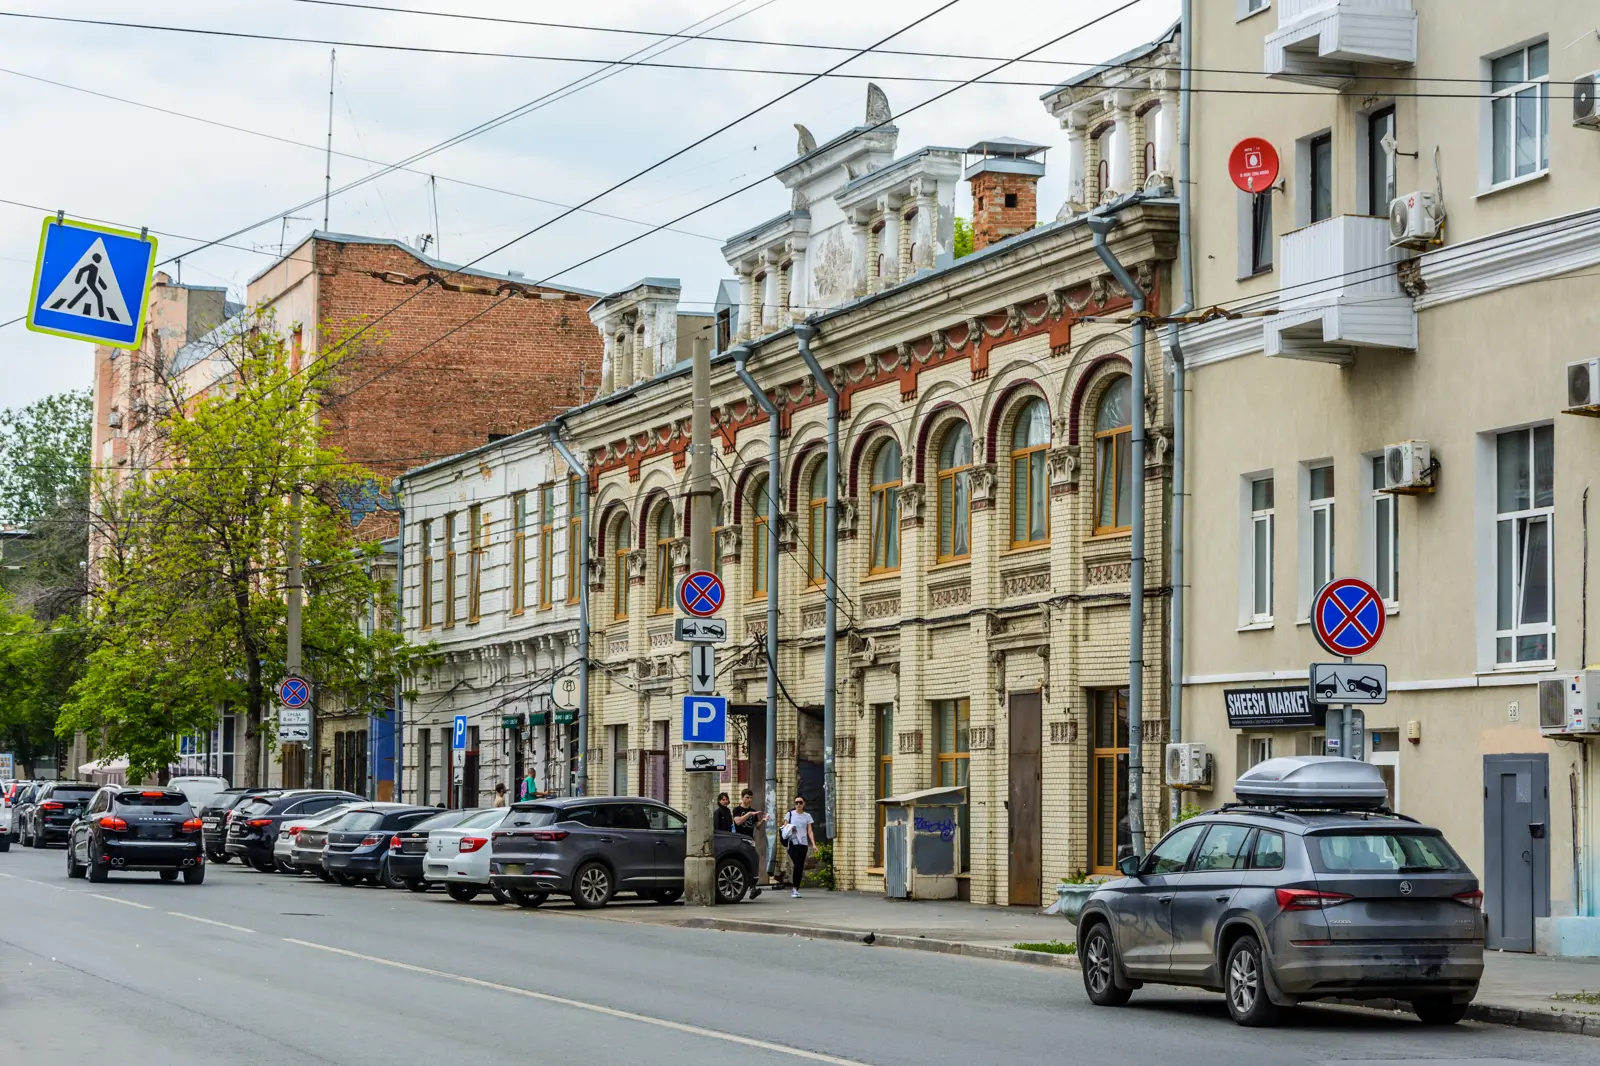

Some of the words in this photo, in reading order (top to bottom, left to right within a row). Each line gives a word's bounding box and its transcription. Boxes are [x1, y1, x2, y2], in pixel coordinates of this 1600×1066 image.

[1227, 692, 1267, 716] SHEESH
[1267, 690, 1309, 714] MARKET
[456, 719, 464, 745] P
[692, 701, 717, 737] P
